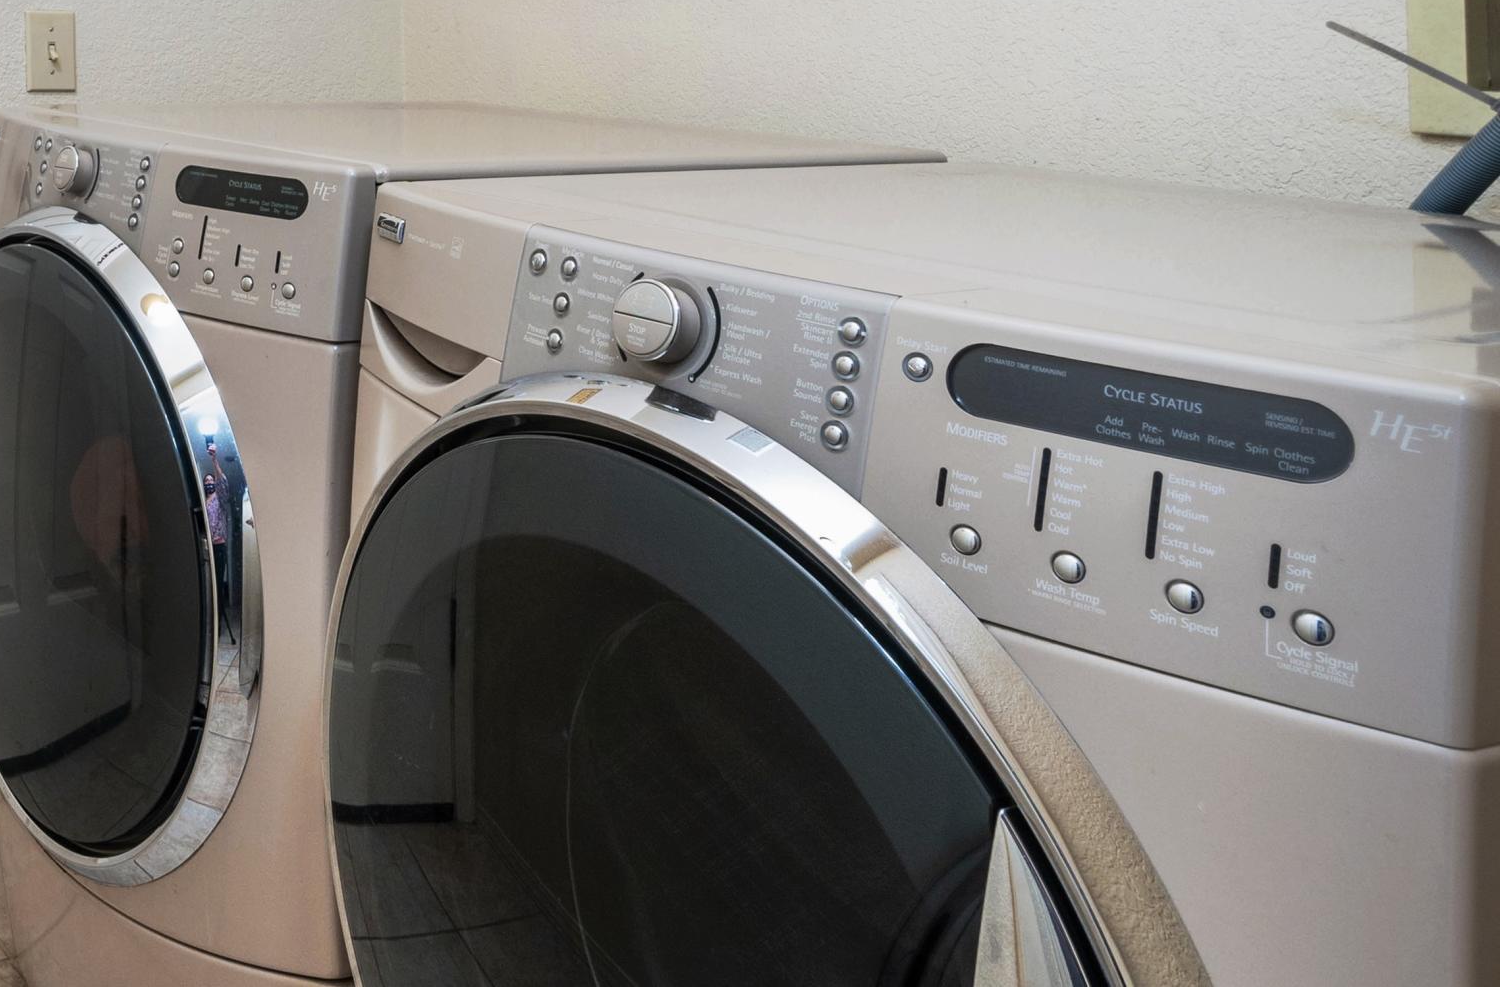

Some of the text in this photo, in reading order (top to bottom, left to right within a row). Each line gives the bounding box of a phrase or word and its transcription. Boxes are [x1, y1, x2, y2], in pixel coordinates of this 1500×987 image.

[800, 294, 839, 312] OPTIONS
[896, 335, 949, 354] Delay Start
[796, 377, 824, 393] Button
[793, 388, 822, 404] Sounds
[1103, 384, 1203, 414] CYCLE STATUS
[800, 410, 820, 423] Save
[1104, 415, 1125, 427] Add
[790, 419, 818, 435] Energy
[946, 421, 1009, 447] MODIFIERS
[1095, 423, 1131, 441] Clothes
[1141, 421, 1163, 435] Pre-
[1171, 427, 1201, 443] Wash
[1138, 432, 1166, 447] Wash
[1207, 434, 1236, 450] Rinse
[1245, 442, 1269, 456] Spin
[1274, 447, 1316, 465] Clothes
[1056, 449, 1105, 468] Extra Hot
[1054, 463, 1074, 476] Hot
[1278, 460, 1310, 476] Clean
[952, 469, 979, 485] Heavy
[1168, 473, 1226, 496] Extra High
[950, 483, 983, 499] Normal
[1166, 488, 1193, 503] High
[947, 498, 971, 512] Light
[1052, 492, 1081, 508] Warm
[1050, 508, 1071, 521] Cool
[1164, 503, 1209, 524] Medium
[1048, 522, 1069, 535] Cold
[1162, 519, 1185, 533] Low
[1161, 535, 1216, 557] Extra Low
[940, 552, 988, 574] Soil Level
[1159, 550, 1203, 570] No Spin
[1286, 547, 1317, 564] Loud
[1285, 564, 1313, 580] Soft
[1035, 577, 1100, 605] Wash Temp
[1284, 580, 1306, 593] Off
[1150, 608, 1220, 638] Spin Speed
[1276, 641, 1358, 673] Cycle Signal
